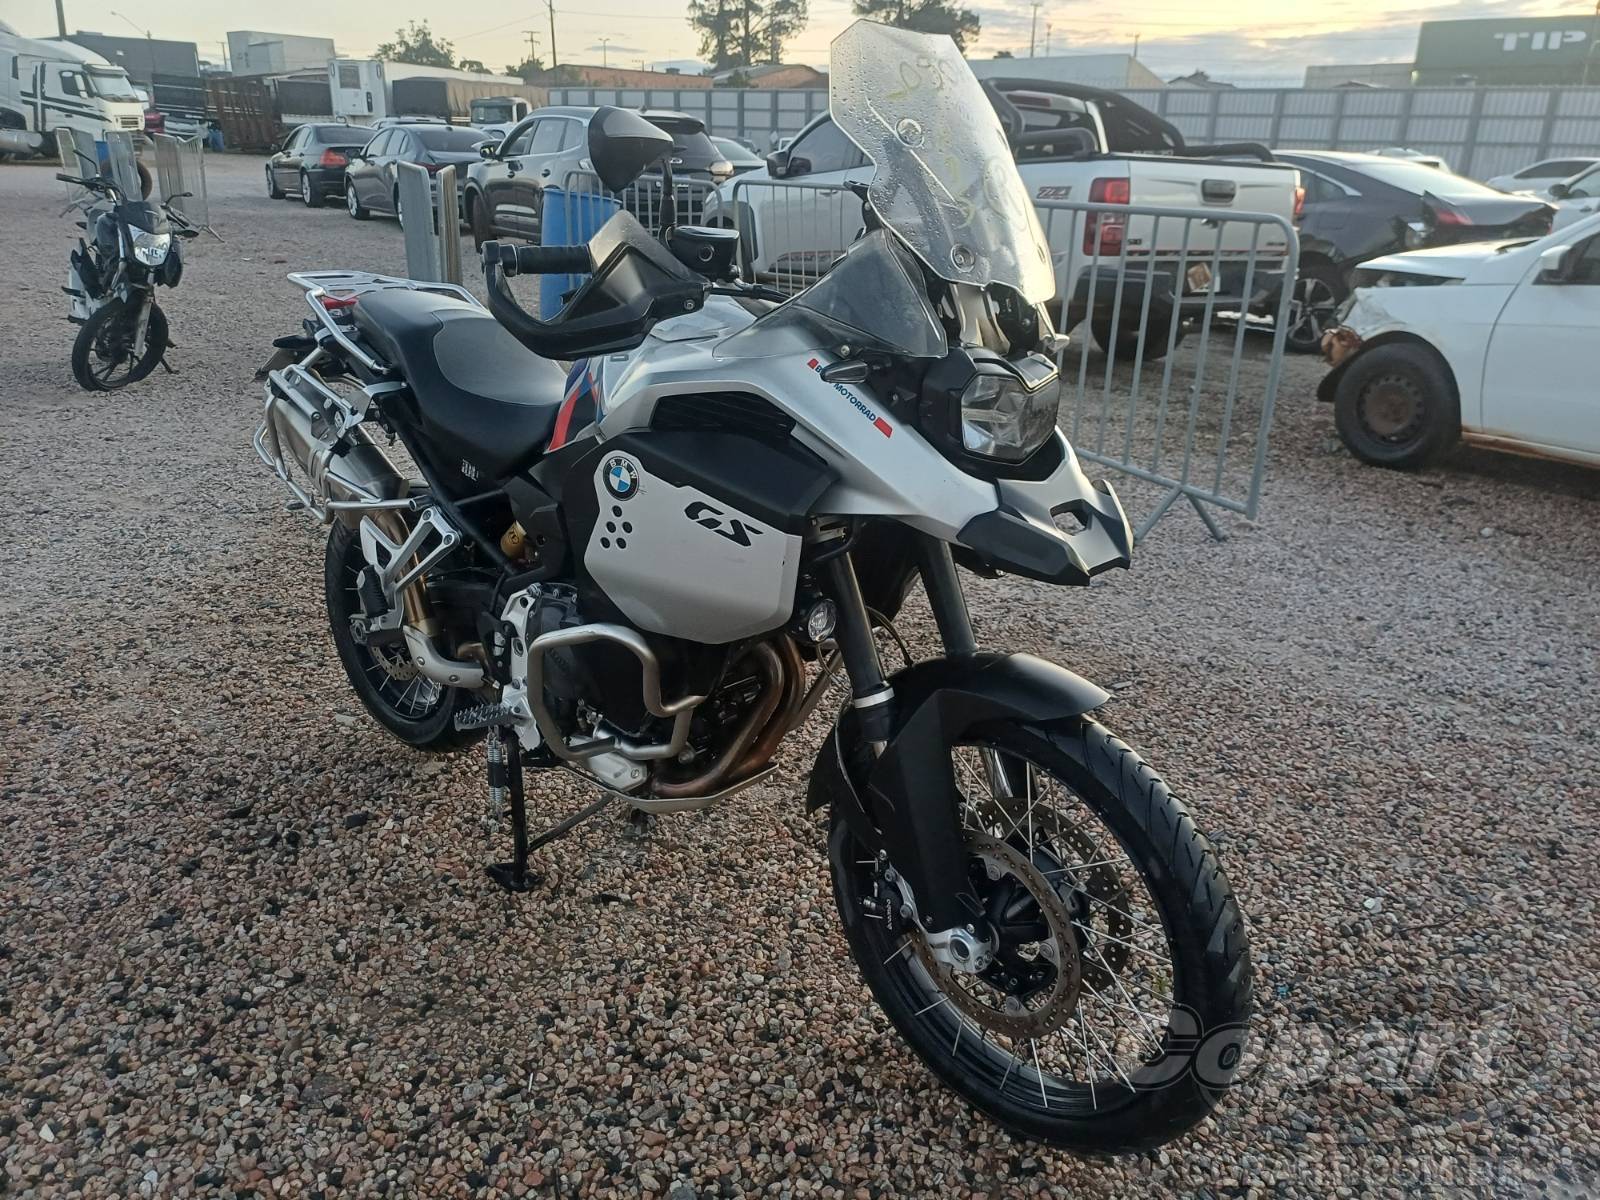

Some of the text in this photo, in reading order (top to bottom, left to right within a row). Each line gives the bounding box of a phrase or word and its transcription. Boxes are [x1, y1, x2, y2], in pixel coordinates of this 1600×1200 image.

[1494, 30, 1587, 51] TIP
[833, 382, 877, 421] MOTORRAD
[609, 458, 637, 480] BMW
[684, 501, 764, 547] GS
